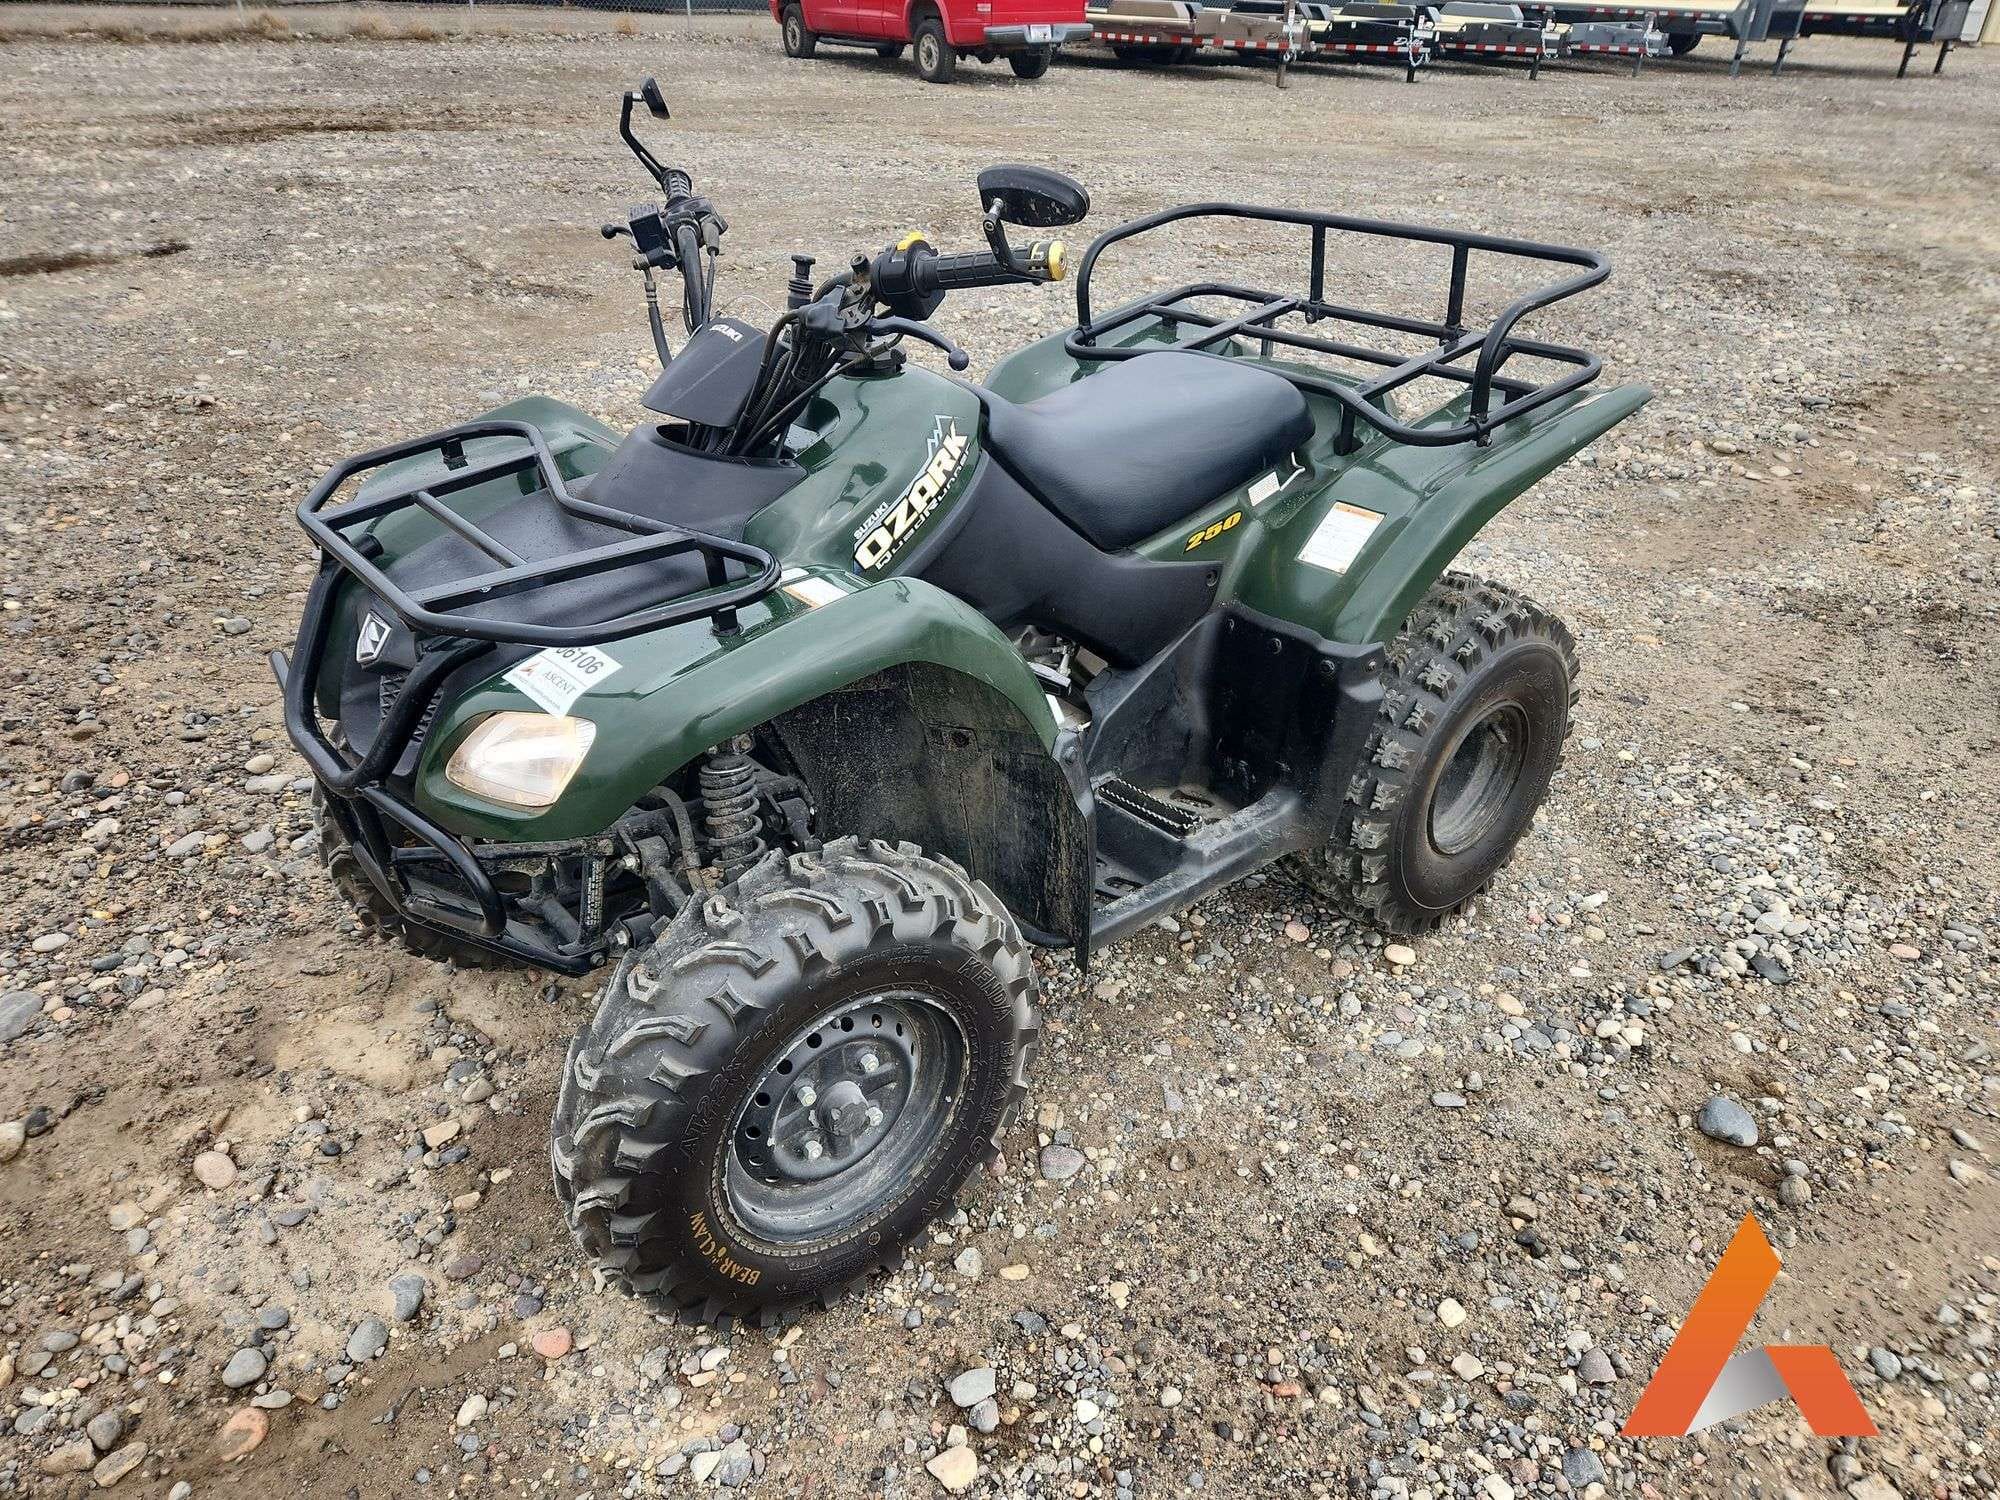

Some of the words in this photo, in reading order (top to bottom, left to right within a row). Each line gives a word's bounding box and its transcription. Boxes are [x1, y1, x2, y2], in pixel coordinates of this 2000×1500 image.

[854, 417, 968, 570] OZARK
[853, 501, 889, 539] SUZUKI
[1185, 511, 1242, 553] 250
[543, 671, 577, 696] ASCENT
[957, 955, 1015, 1023] KENDA
[689, 1210, 717, 1256] CLAW
[719, 1257, 761, 1286] BEAR
